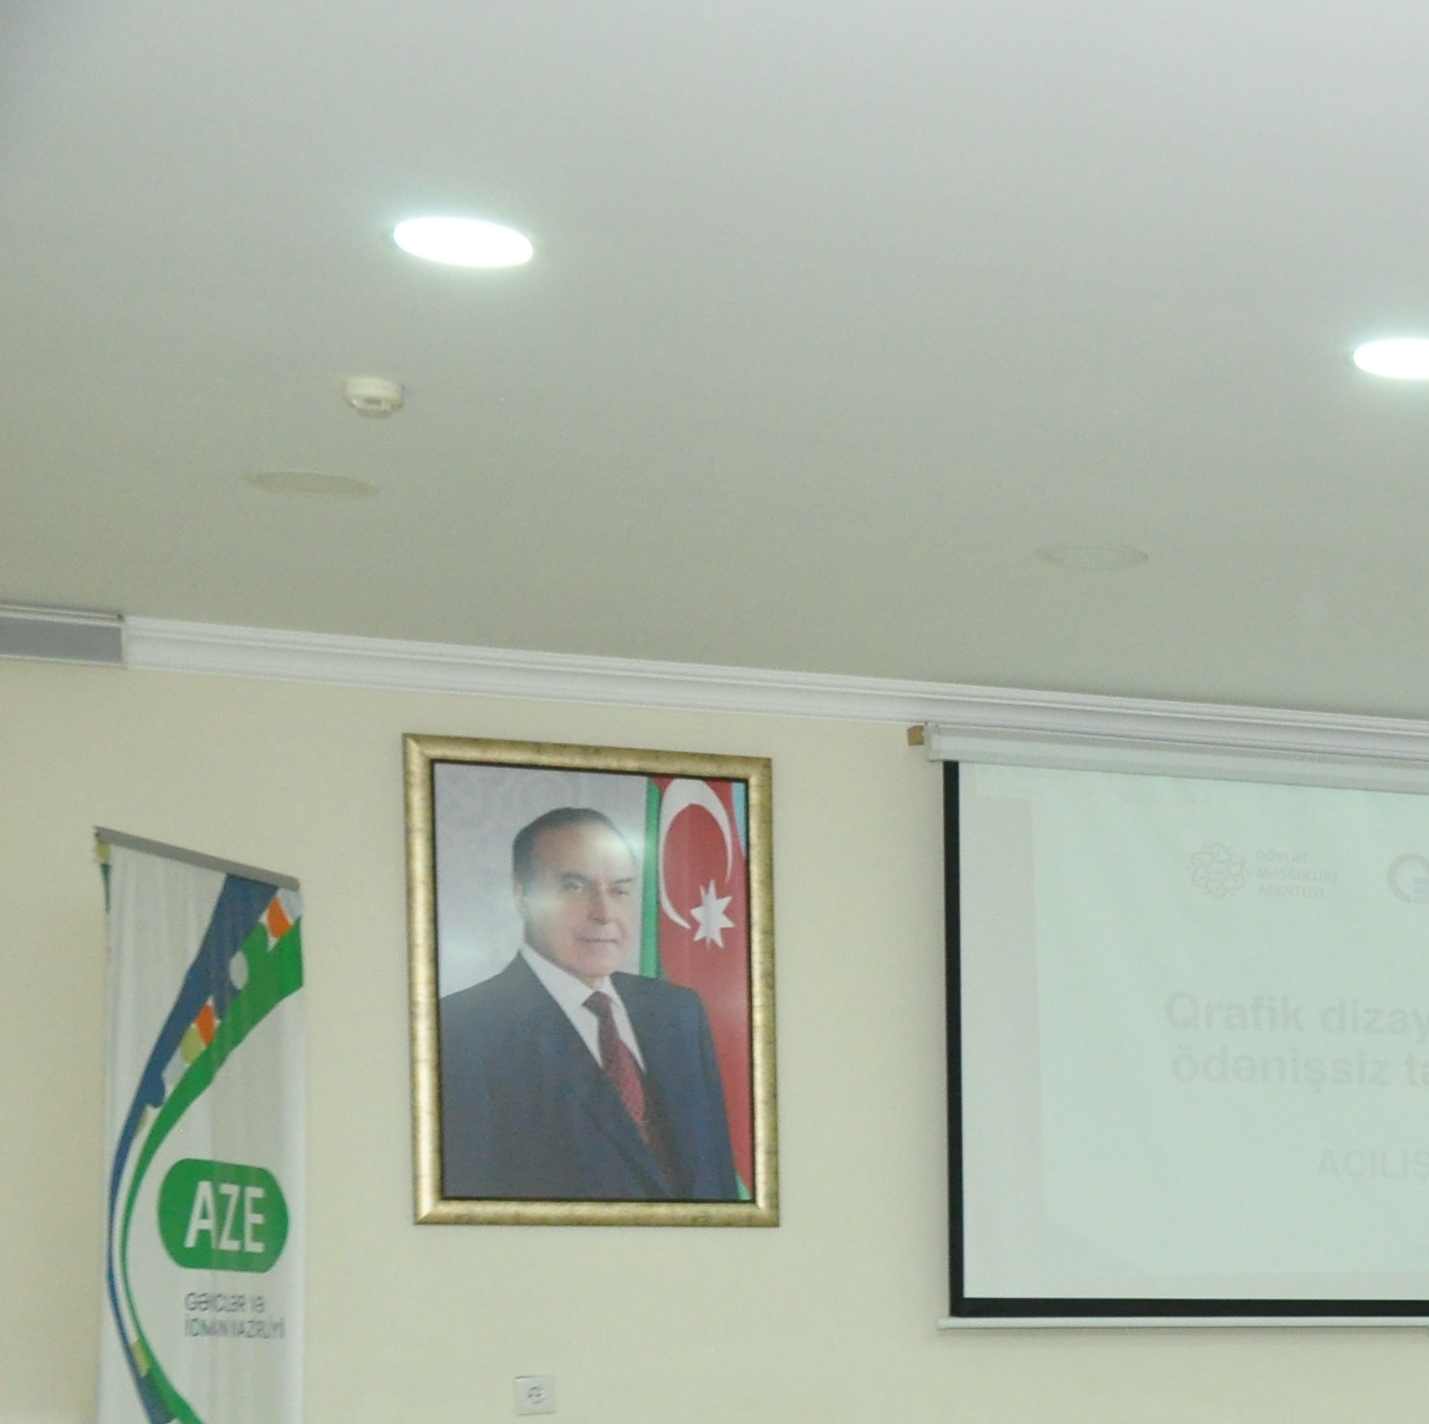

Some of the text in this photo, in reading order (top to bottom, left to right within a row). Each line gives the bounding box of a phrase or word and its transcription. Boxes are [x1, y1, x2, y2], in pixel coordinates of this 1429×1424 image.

[1164, 990, 1305, 1031] Qrafik
[1171, 1043, 1391, 1095] ödənişsiz
[184, 1180, 265, 1254] AZE
